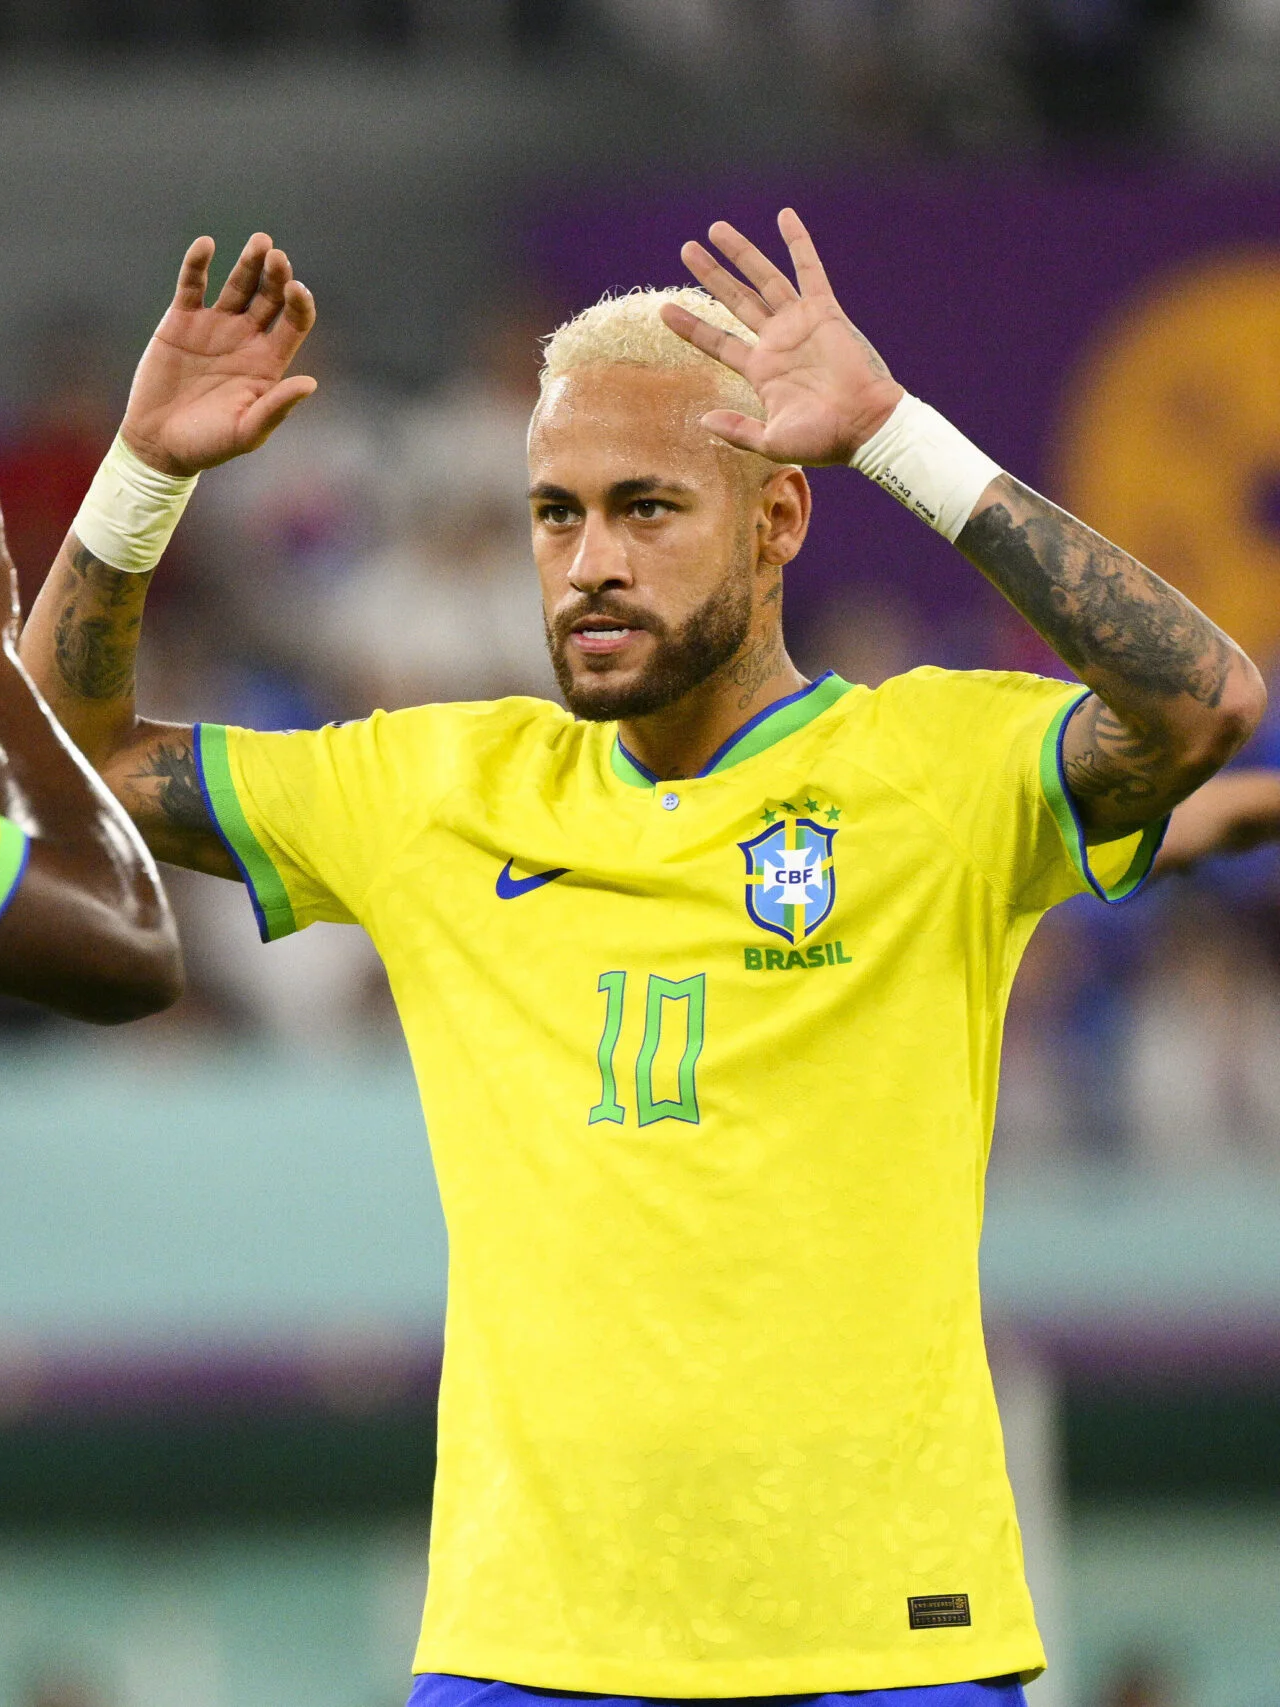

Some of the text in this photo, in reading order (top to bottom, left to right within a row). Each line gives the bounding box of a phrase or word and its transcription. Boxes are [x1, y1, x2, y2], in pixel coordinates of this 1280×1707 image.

[885, 467, 911, 498] DEUS
[775, 868, 814, 884] CBF
[743, 941, 853, 971] BRASIL
[587, 970, 707, 1128] 10
